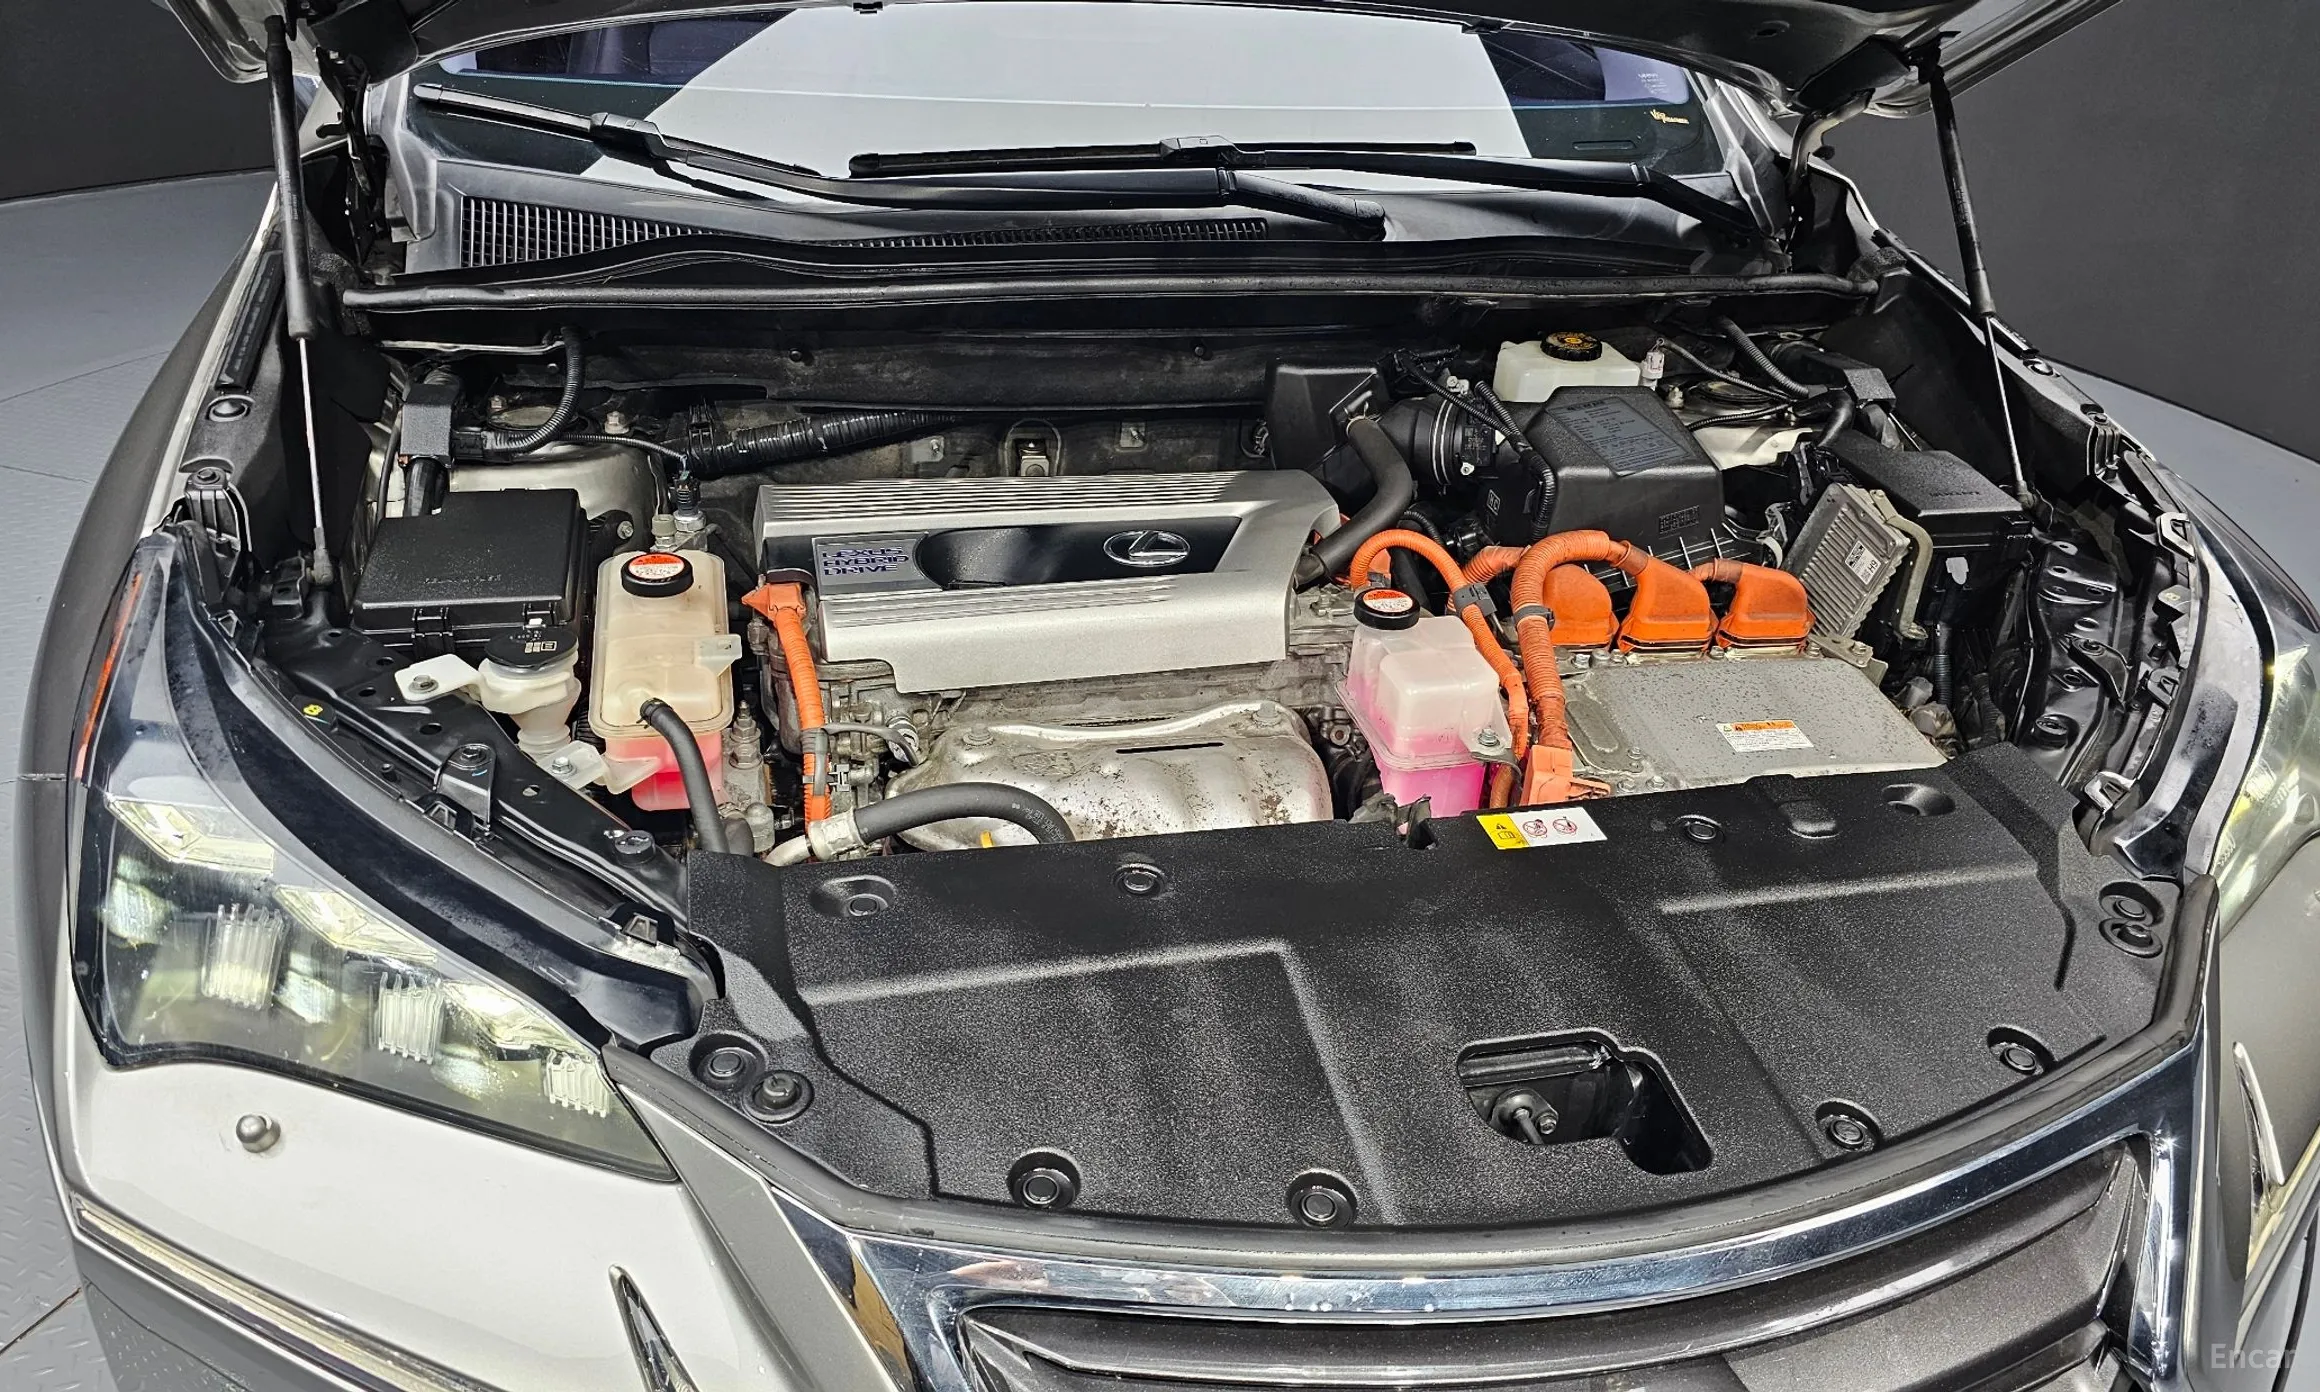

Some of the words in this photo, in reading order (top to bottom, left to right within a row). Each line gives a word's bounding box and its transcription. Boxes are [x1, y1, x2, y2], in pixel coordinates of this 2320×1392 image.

[822, 547, 903, 558] LEXUS
[823, 555, 909, 567] HYBRID
[823, 564, 898, 576] DRIVE
